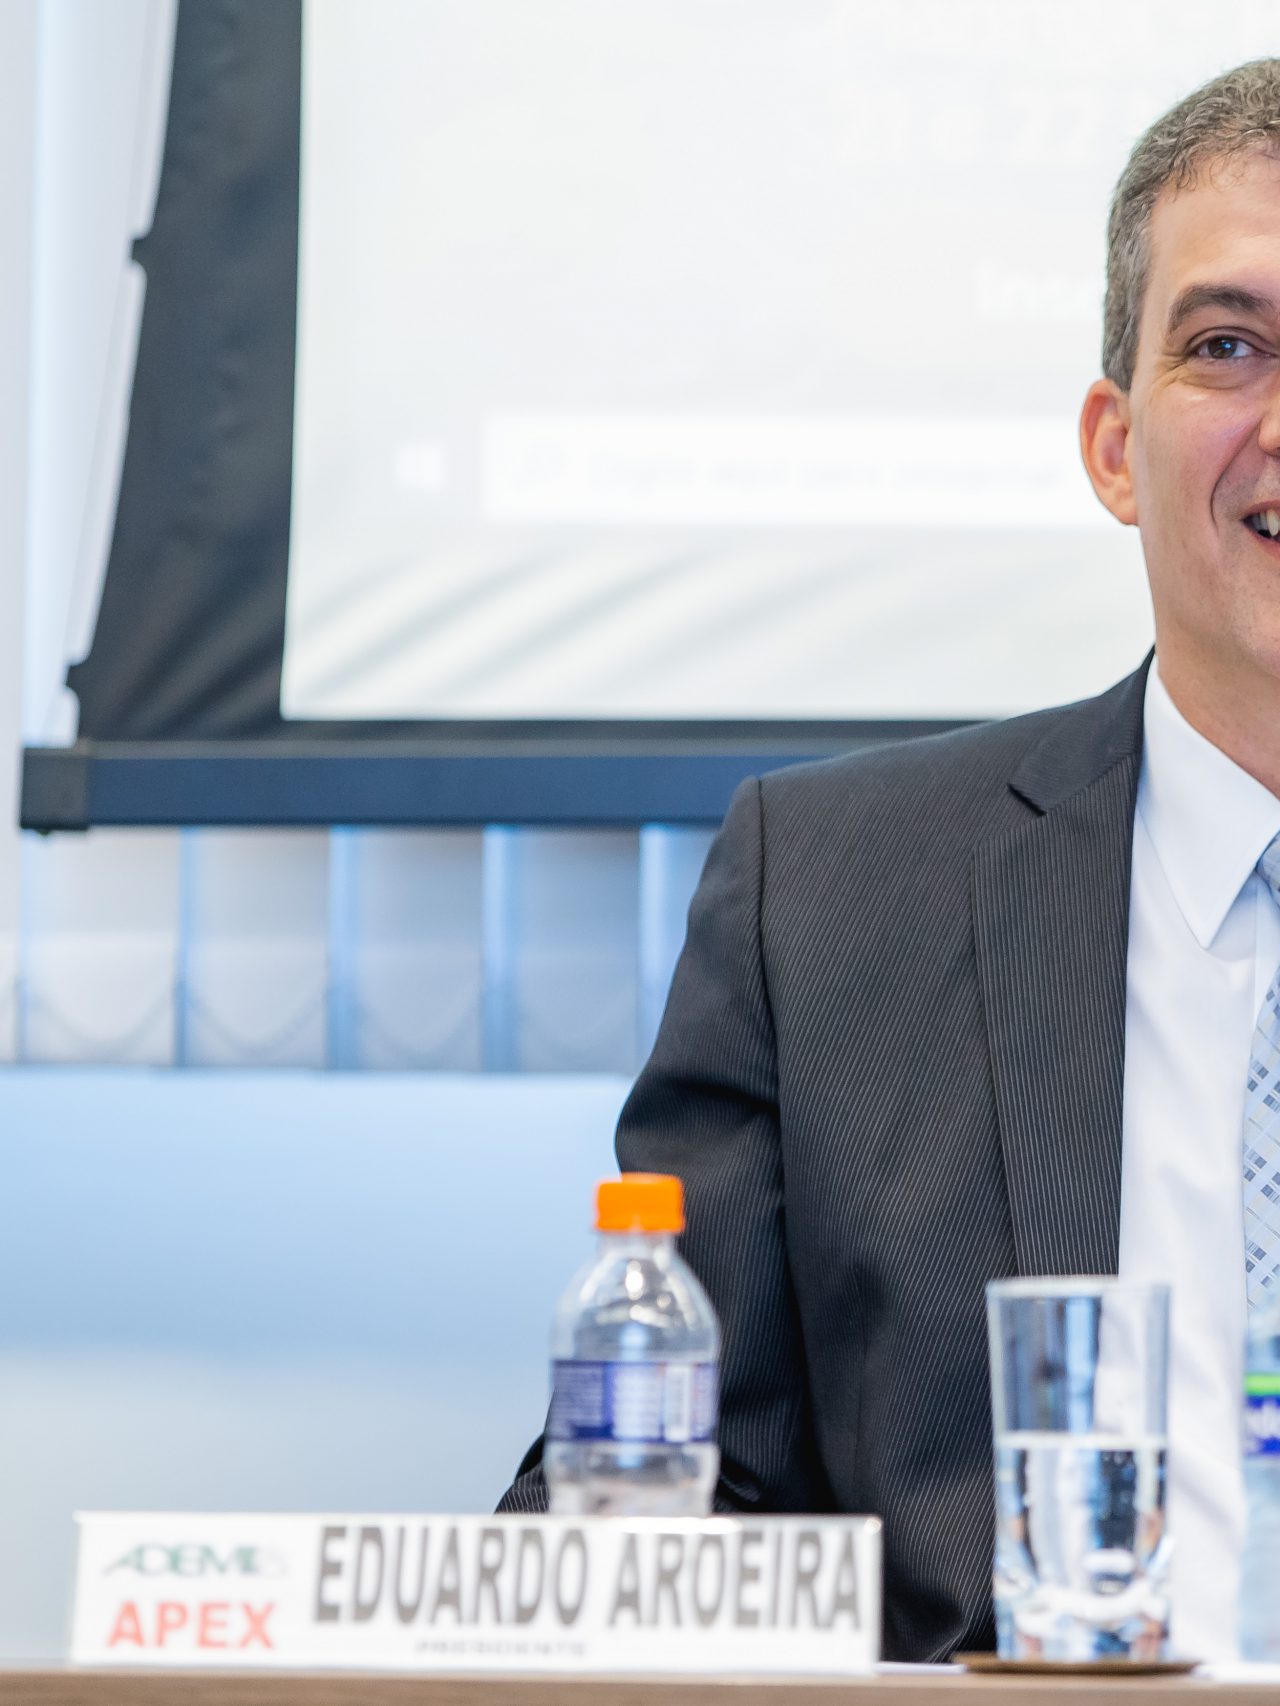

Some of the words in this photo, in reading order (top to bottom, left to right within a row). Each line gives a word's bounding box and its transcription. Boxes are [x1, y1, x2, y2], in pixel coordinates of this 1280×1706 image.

[314, 1525, 588, 1627] EDUARDO
[606, 1528, 862, 1629] AROEIRA
[107, 1600, 276, 1650] APEX
